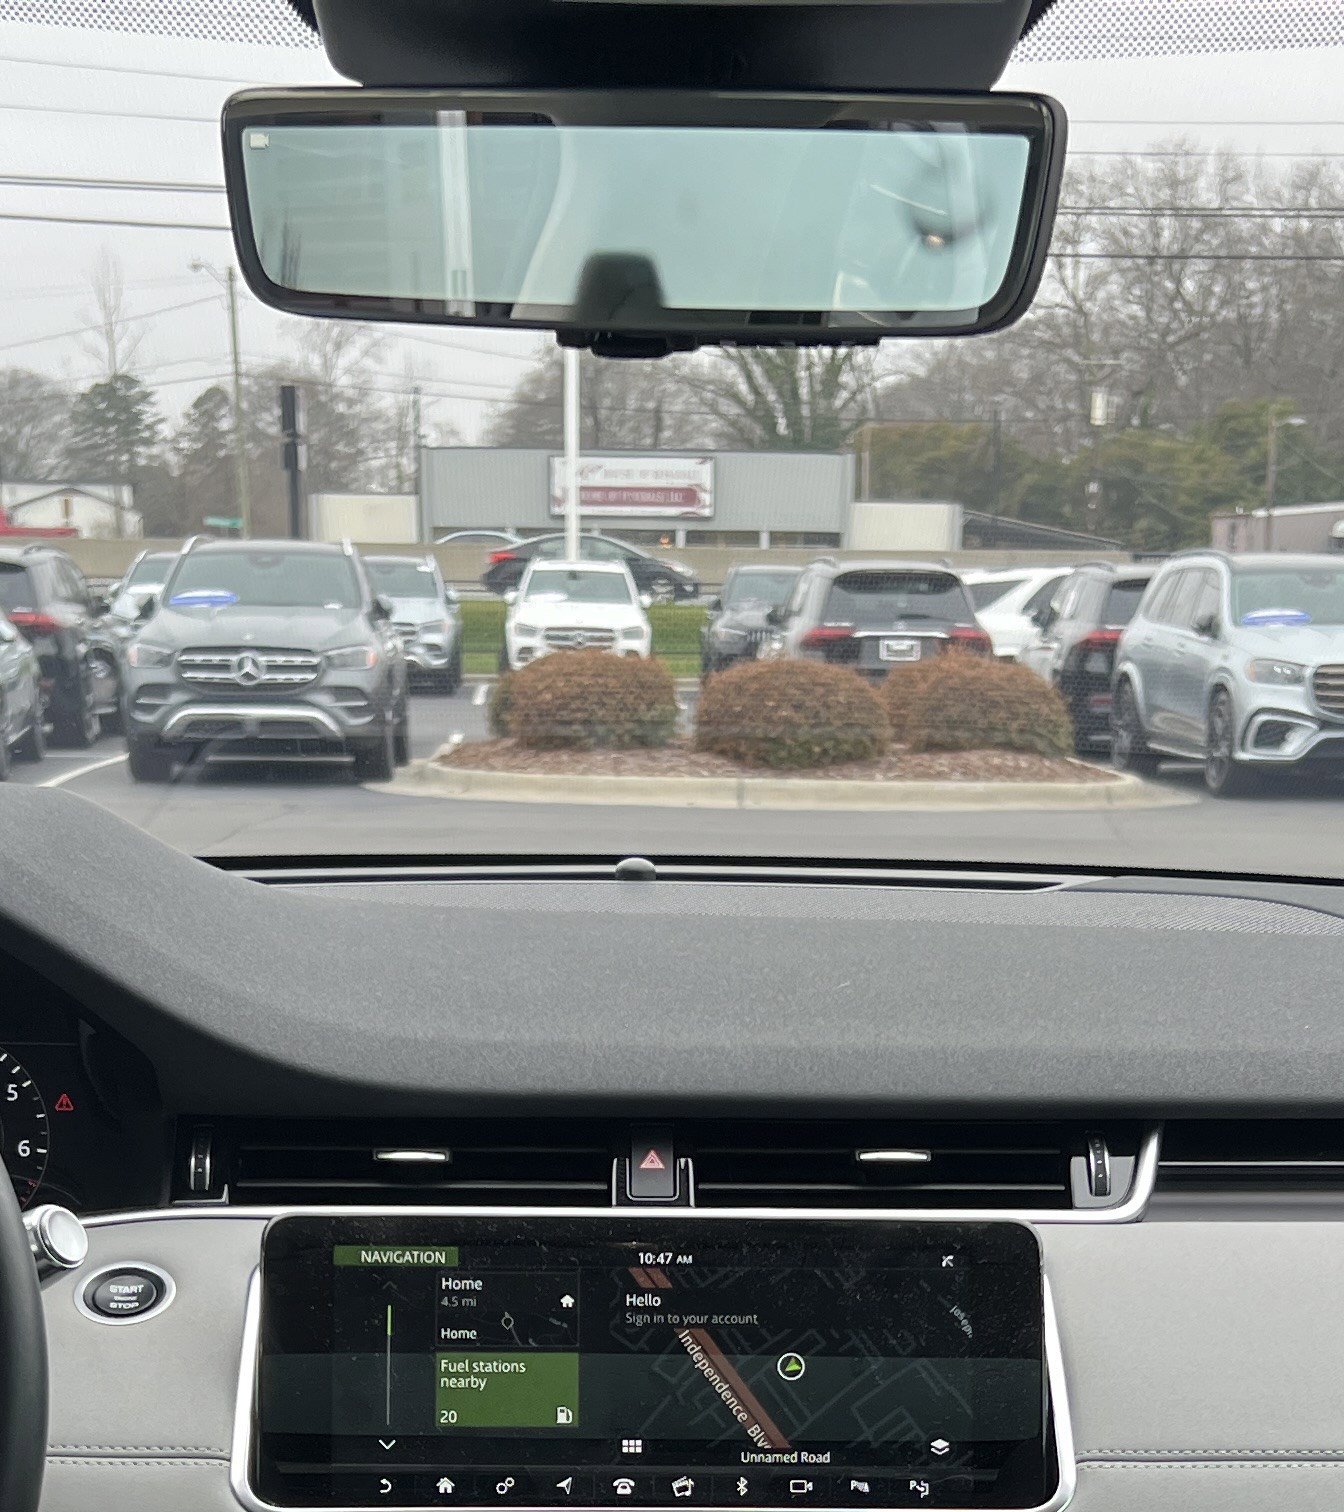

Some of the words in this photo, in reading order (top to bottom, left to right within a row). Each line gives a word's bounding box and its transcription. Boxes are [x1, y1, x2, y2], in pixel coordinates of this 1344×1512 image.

[6, 1084, 19, 1101] 5
[17, 1140, 31, 1157] 6
[360, 1250, 446, 1265] NAVIGATION
[638, 1252, 674, 1265] 10:47
[676, 1255, 693, 1265] AM
[109, 1284, 144, 1294] START
[441, 1277, 483, 1291] Home
[109, 1301, 140, 1310] STOP
[440, 1296, 459, 1308] 4.5
[461, 1296, 477, 1307] mi
[625, 1293, 662, 1307] Hello
[625, 1311, 651, 1326] Sign
[653, 1312, 665, 1324] in
[667, 1313, 680, 1325] to
[682, 1315, 709, 1327] your
[711, 1313, 759, 1325] account
[440, 1328, 478, 1340] Home
[440, 1359, 470, 1373] Fuel
[472, 1359, 526, 1373] stations
[440, 1375, 488, 1391] nearby
[678, 1329, 748, 1424] Independence
[440, 1410, 458, 1424] 20
[741, 1451, 798, 1464] Unnamed
[800, 1451, 831, 1464] Road
